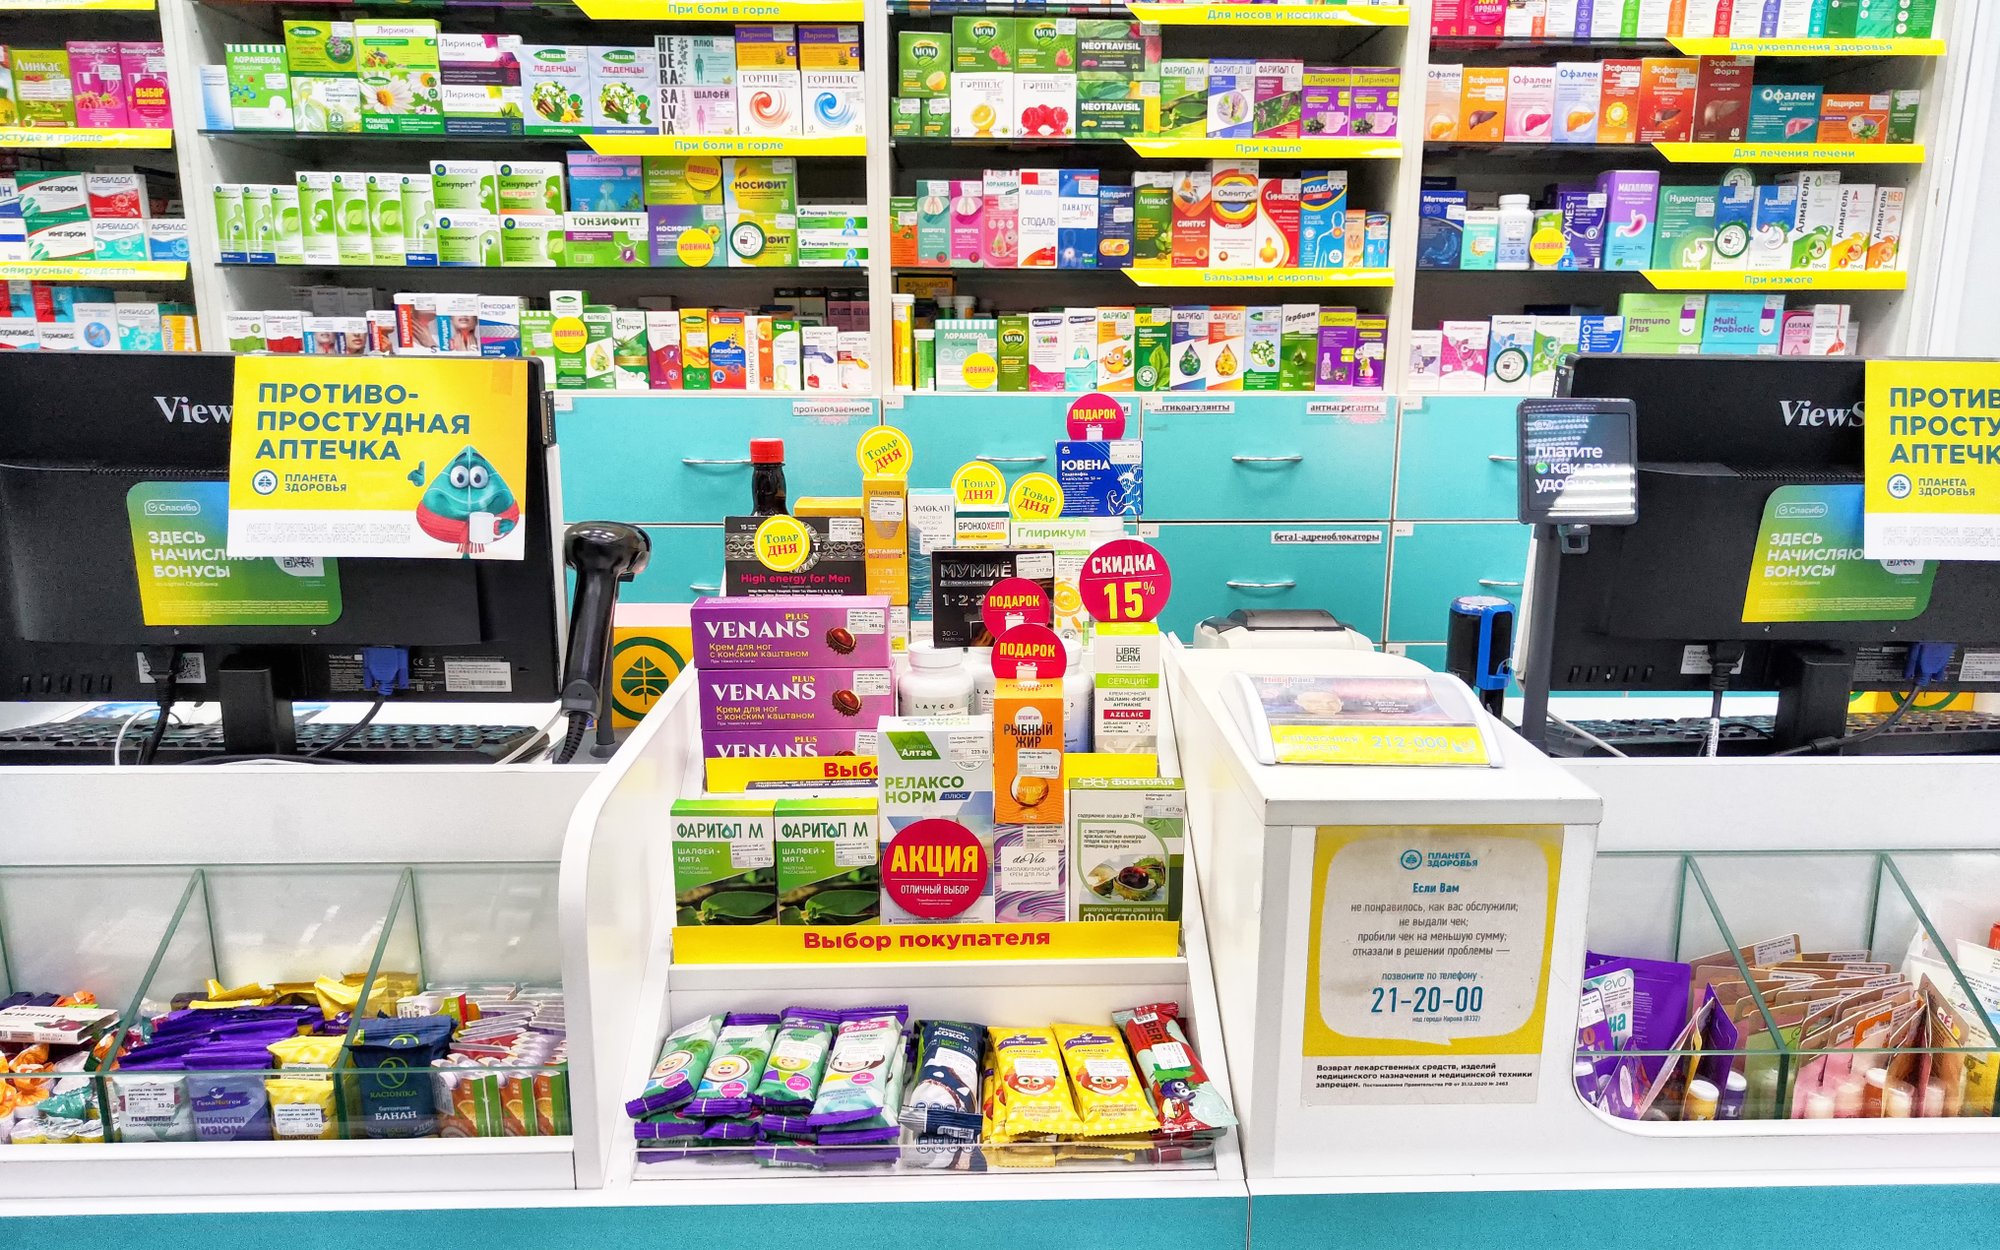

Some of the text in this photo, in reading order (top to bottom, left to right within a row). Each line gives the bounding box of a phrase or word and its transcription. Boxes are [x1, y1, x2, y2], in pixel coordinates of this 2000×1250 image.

[668, 4, 693, 15] При
[698, 5, 728, 14] боли
[743, 7, 780, 15] горле
[1207, 10, 1231, 20] Для
[1236, 11, 1272, 19] носов
[1081, 41, 1141, 51] NEOTRAVISIL
[1730, 42, 1893, 52] Для укрепления здоровья
[533, 65, 577, 73] ЛЕДЕНЦЫ
[135, 88, 165, 98] ВЫБОР
[693, 90, 730, 99] ШАЛФЕЙ
[675, 141, 699, 151] При
[703, 141, 733, 150] боли
[748, 143, 784, 151] горле
[1235, 144, 1302, 154] При кашле
[1733, 148, 1855, 159] Для лечения печени
[90, 176, 133, 184] АРБИДОЛ
[734, 180, 788, 190] НОСИФИТ
[1265, 191, 1299, 201] Синекод
[1795, 174, 1811, 233] Алмагель
[572, 217, 641, 226] ТОНЗИФИТТ
[1021, 217, 1057, 227] СТОДАЛЬ
[1177, 220, 1207, 228] СИНТУС
[1204, 272, 1324, 283] Бальзамы сиропы
[1744, 275, 1813, 285] При изжоге
[480, 301, 516, 311] Гексорал
[1629, 316, 1671, 325] Immuno
[1713, 316, 1737, 325] Multi
[1628, 325, 1649, 333] Plus
[1712, 325, 1755, 334] Probiotic
[258, 382, 419, 405] ПРОТИВО-
[793, 405, 870, 415] противоязвенное
[1072, 408, 1116, 422] ПОДАРОК
[257, 410, 471, 436] ПРОСТУДНАЯ
[255, 438, 401, 461] АПТЕЧКА
[874, 448, 903, 473] ДНЯ
[1061, 459, 1111, 471] ЮВЕНА
[284, 473, 338, 483] ПЛАНЕТА
[1918, 478, 1968, 487] ПЛАНЕТА
[284, 483, 347, 493] ЗДОРОВЬЯ
[1918, 487, 1976, 497] ЗДОРОВЬЯ
[158, 503, 198, 513] Спасибо
[958, 522, 1005, 531] БРОНХОХЕЛП
[148, 530, 205, 546] ЗДЕСЬ
[1016, 527, 1087, 541] Глирикум
[1769, 533, 1823, 546] ЗДЕСЬ
[940, 561, 1012, 578] МУМИЁ
[1091, 553, 1156, 575] СКИДКА
[153, 565, 231, 579] БОНУСЫ
[740, 573, 850, 587] High energy for Men
[785, 613, 809, 621] PLUS
[703, 621, 810, 638] VENANS
[709, 643, 735, 652] Крем
[737, 644, 754, 652] для
[711, 683, 816, 701] VENANS
[914, 703, 955, 711] LAYCO
[1003, 721, 1054, 737] РЫБНЫЙ
[1015, 736, 1042, 749] ЖИР
[1371, 735, 1448, 749] 212-000
[901, 748, 933, 757] Алтае
[885, 775, 965, 789] РЕЛАКСО
[885, 791, 937, 804] НОРМ
[677, 822, 742, 839] ФАРИТОЛ
[781, 821, 847, 838] ФАРИТОЛ
[891, 845, 979, 877] АКЦИЯ
[900, 883, 970, 895] ОТЛИЧНЫЙ ВЫБОР
[1413, 883, 1460, 894] Если Вам
[1364, 904, 1426, 913] понравилось,
[1465, 902, 1519, 913] обслужили;
[1412, 919, 1448, 928] выдали
[1450, 919, 1469, 928] чек;
[803, 932, 1050, 952] Выбор покупателя
[1357, 931, 1508, 943] пробили чек на меньшую сумму;
[1352, 945, 1493, 957] отказали в решении проблемы
[1381, 971, 1478, 982] позвоните по телефону
[1603, 975, 1627, 991] evo
[1370, 986, 1484, 1013] 21-20-00
[933, 1030, 970, 1043] КОКОС
[1316, 1062, 1497, 1073] Возврат лекарственных средств, изделий
[1316, 1072, 1378, 1080] медицинского
[1380, 1072, 1429, 1080] назначения
[1439, 1071, 1496, 1080] медицинской
[1498, 1071, 1533, 1079] техники
[1316, 1081, 1361, 1090] запрещен.
[131, 1115, 172, 1123] ГЕМАТОГЕН
[374, 1110, 418, 1121] БАНАН
[201, 1125, 241, 1136] ИЗЮМ
